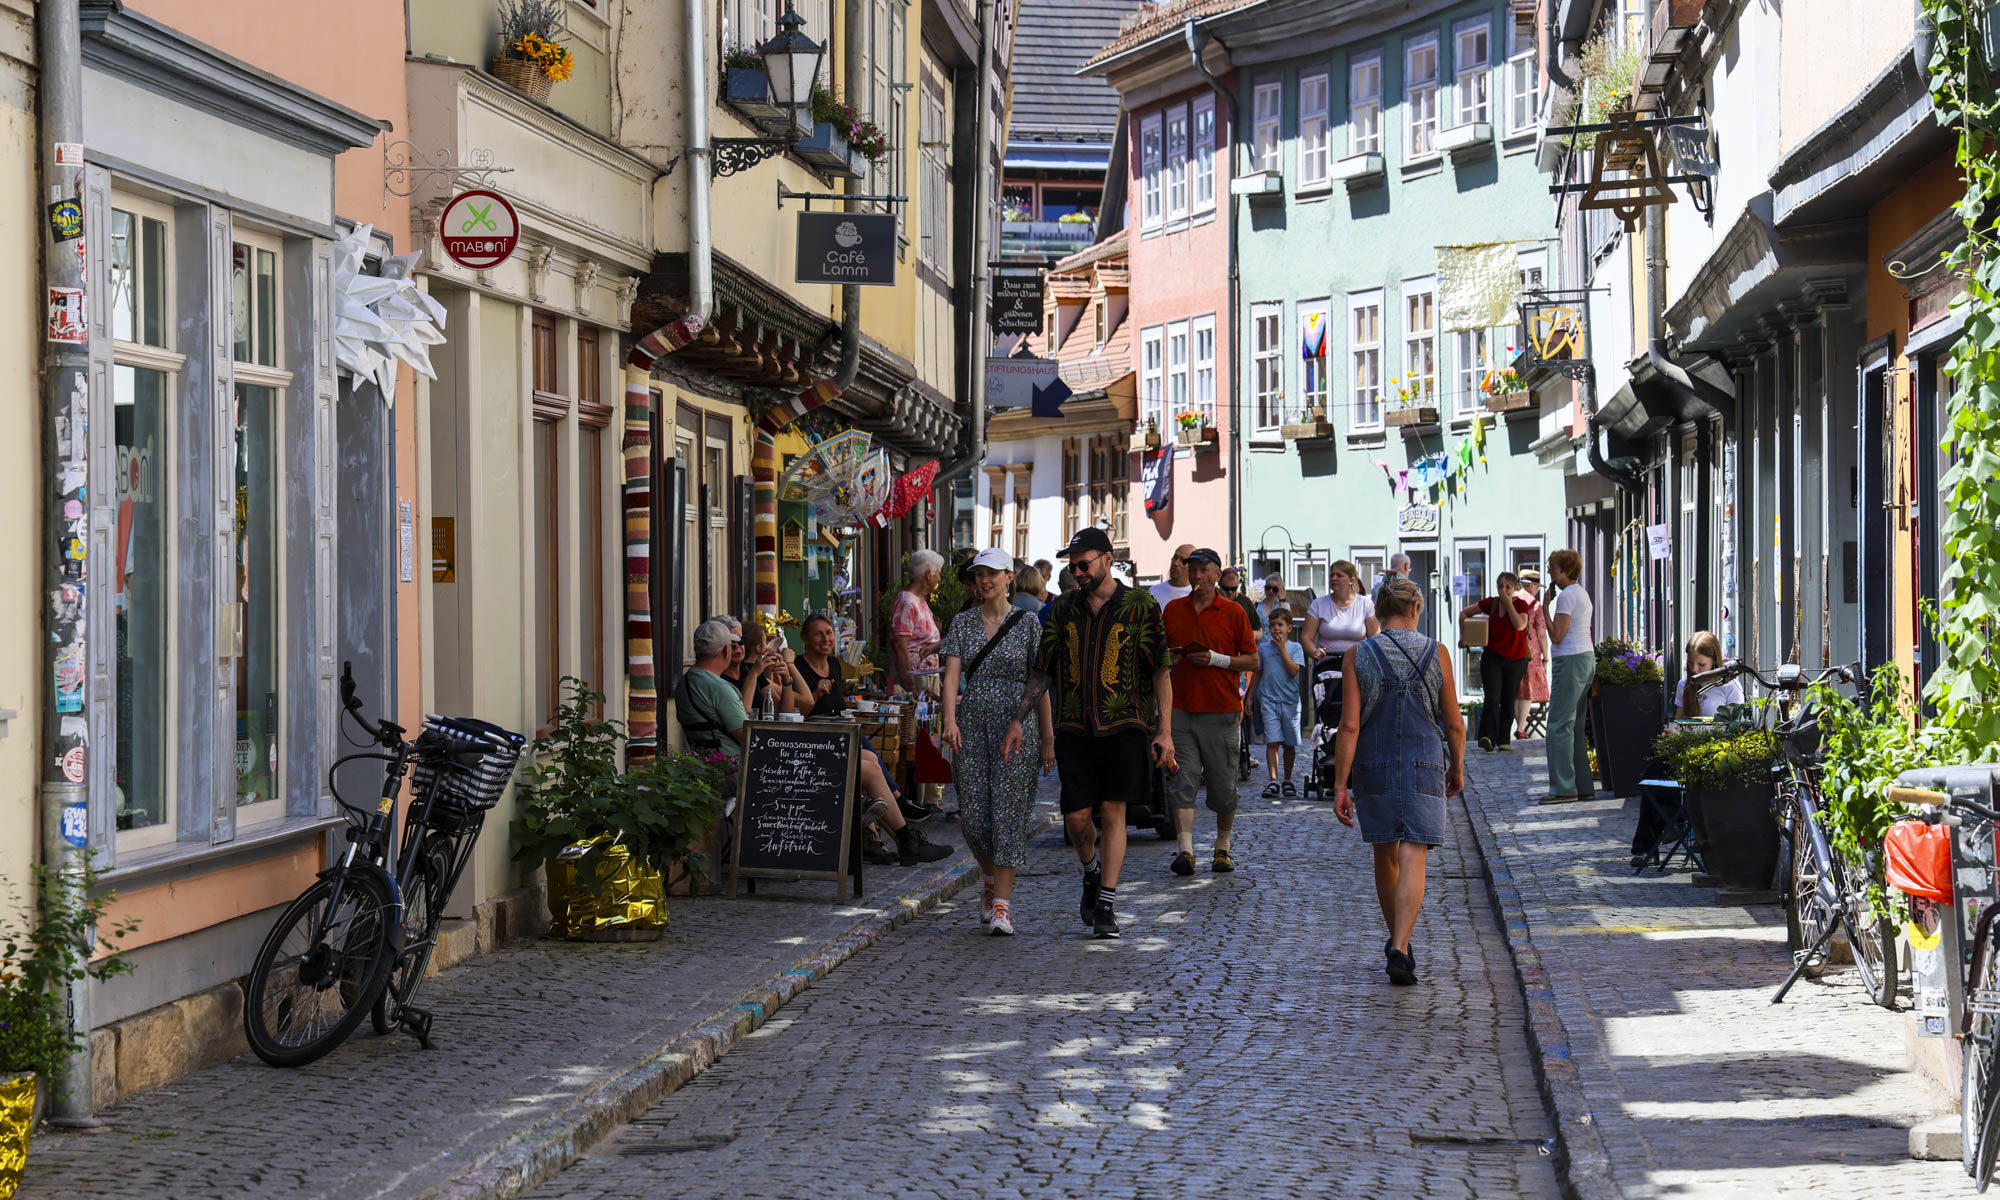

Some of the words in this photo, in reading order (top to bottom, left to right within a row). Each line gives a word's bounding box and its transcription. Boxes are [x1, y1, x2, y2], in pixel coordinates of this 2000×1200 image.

[826, 250, 865, 264] Café
[822, 263, 869, 276] Lamm
[1003, 279, 1021, 289] Haus
[1014, 298, 1023, 310] &
[985, 365, 1057, 375] STIFTUNGSHAUS
[767, 737, 836, 750] Genussmomente
[780, 748, 790, 758] für
[768, 800, 811, 815] Suppe
[760, 838, 817, 857] Aufstrich
